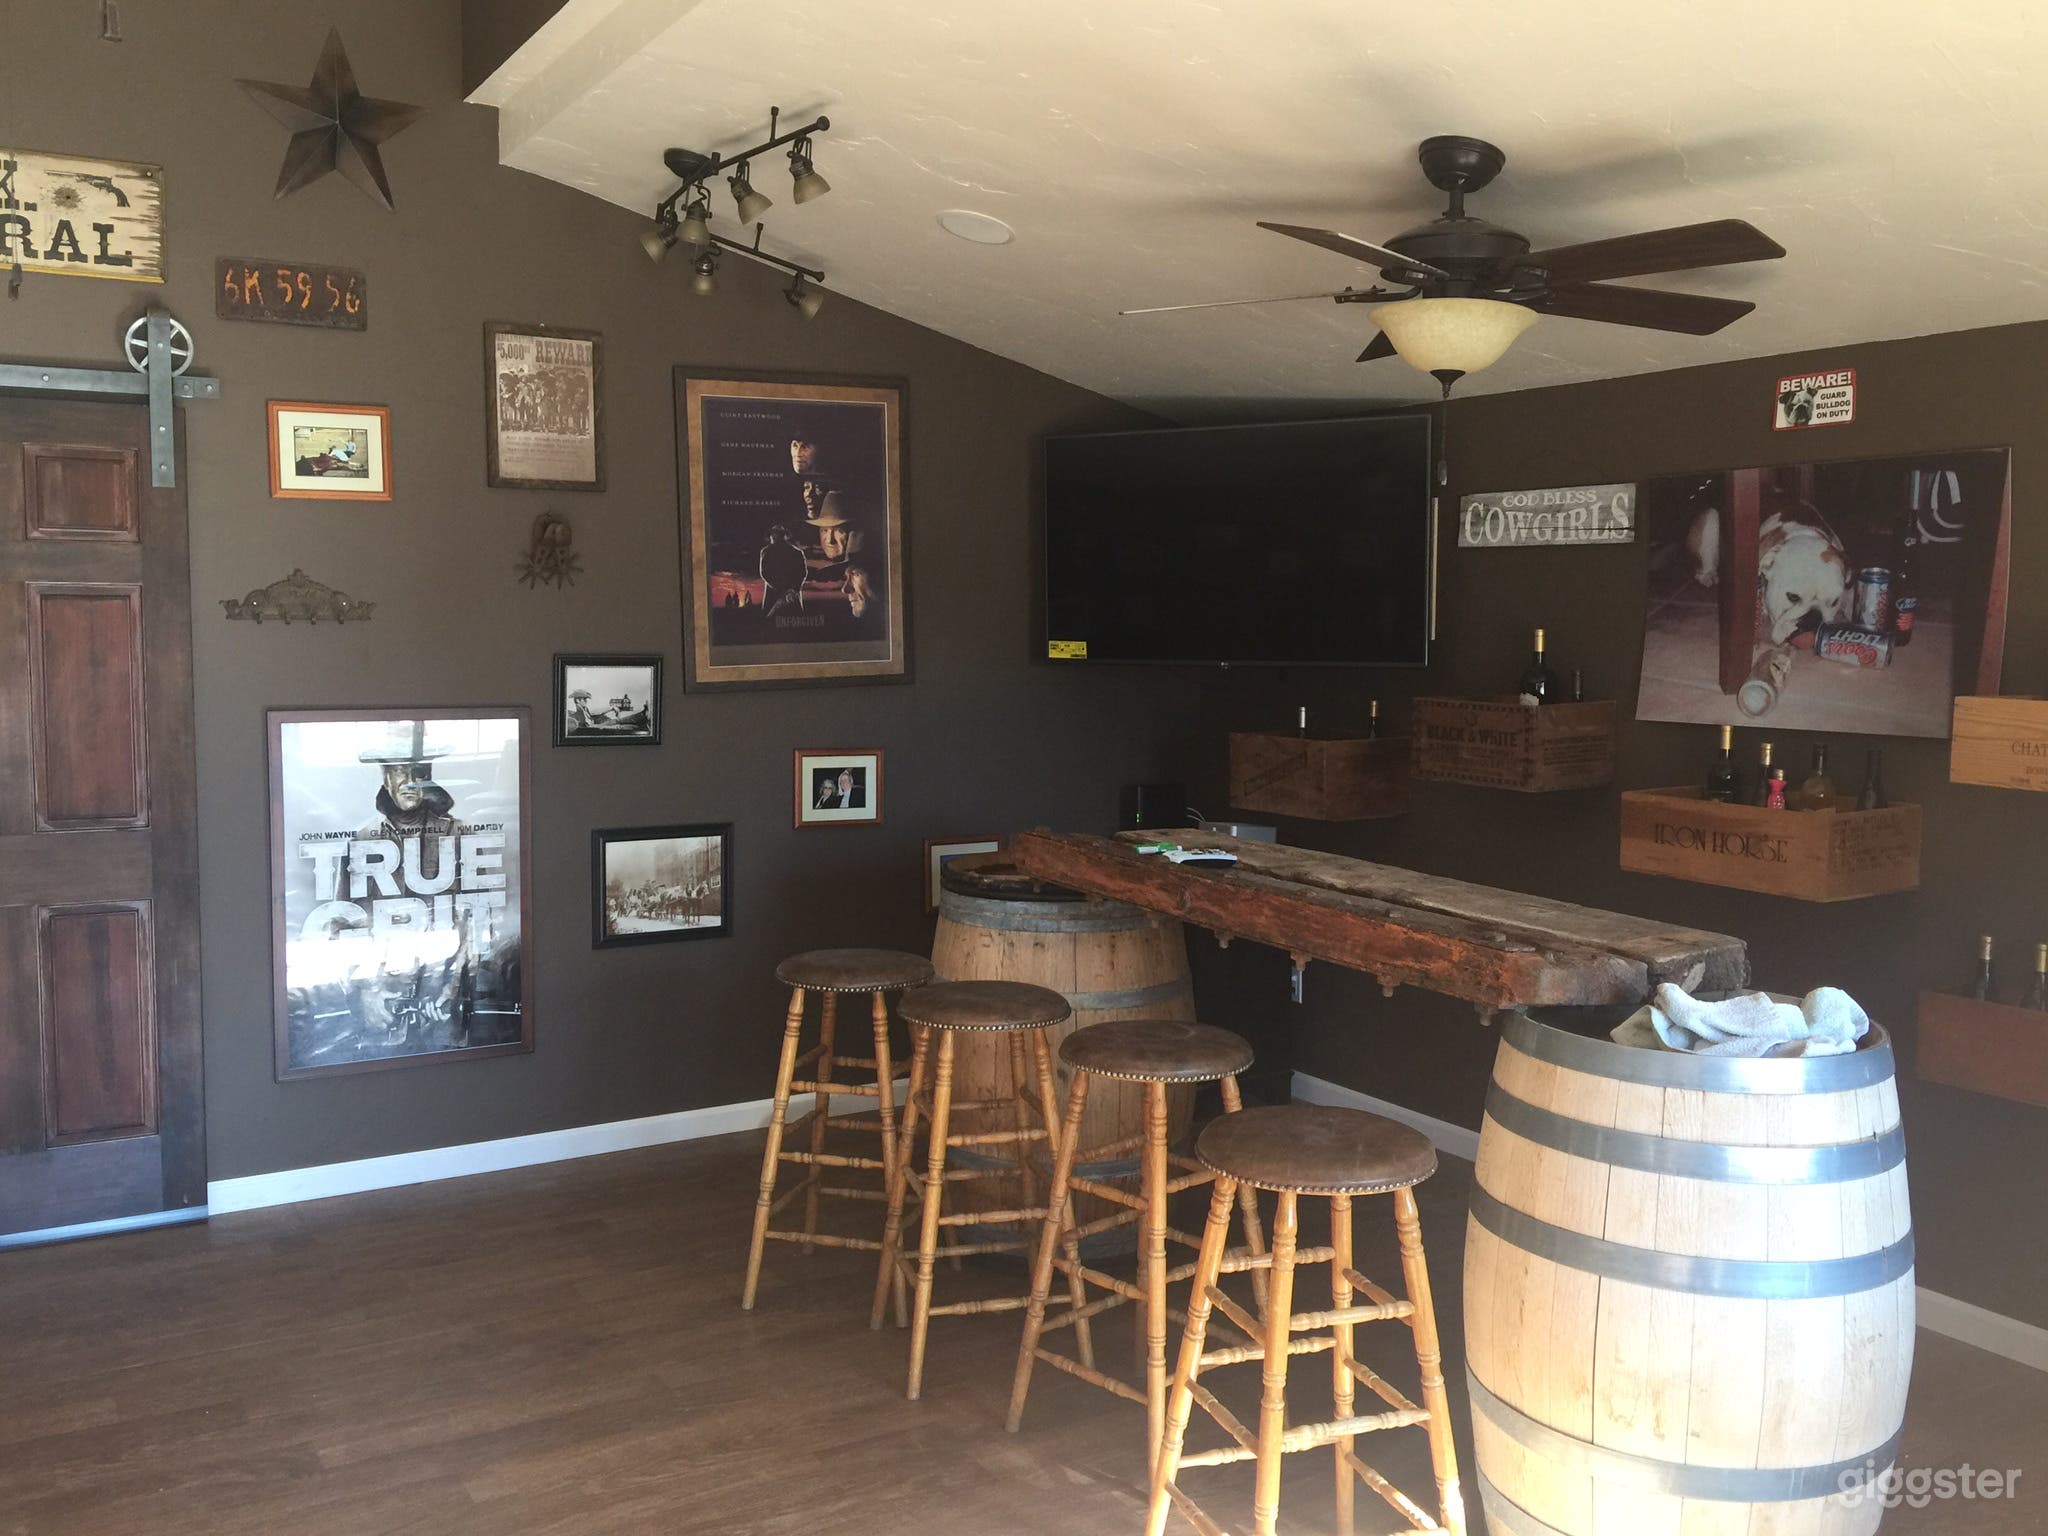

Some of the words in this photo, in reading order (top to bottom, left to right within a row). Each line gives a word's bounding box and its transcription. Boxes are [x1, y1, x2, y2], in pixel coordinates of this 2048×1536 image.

[1780, 371, 1852, 393] BEWARE!
[1816, 400, 1851, 410] BULLDOG
[1820, 391, 1847, 401] GUARD
[1816, 411, 1828, 419] ON
[1829, 409, 1850, 418] DUTY
[1502, 494, 1540, 508] GOD
[1543, 489, 1597, 505] BLESS
[1465, 492, 1629, 544] COWGIRLS
[1830, 629, 1882, 645] LIGHT
[1426, 724, 1465, 742] BLACK
[1479, 729, 1519, 747] WHITE
[299, 832, 323, 841] JOHN
[324, 830, 358, 839] WAYNE
[370, 828, 393, 838] GLEN
[394, 825, 444, 836] CAMPBELL
[457, 824, 472, 833] KIM
[473, 822, 504, 832] DARBY
[1653, 823, 1707, 852] IRON
[1711, 832, 1789, 864] HORSE
[299, 833, 507, 901] TRUE
